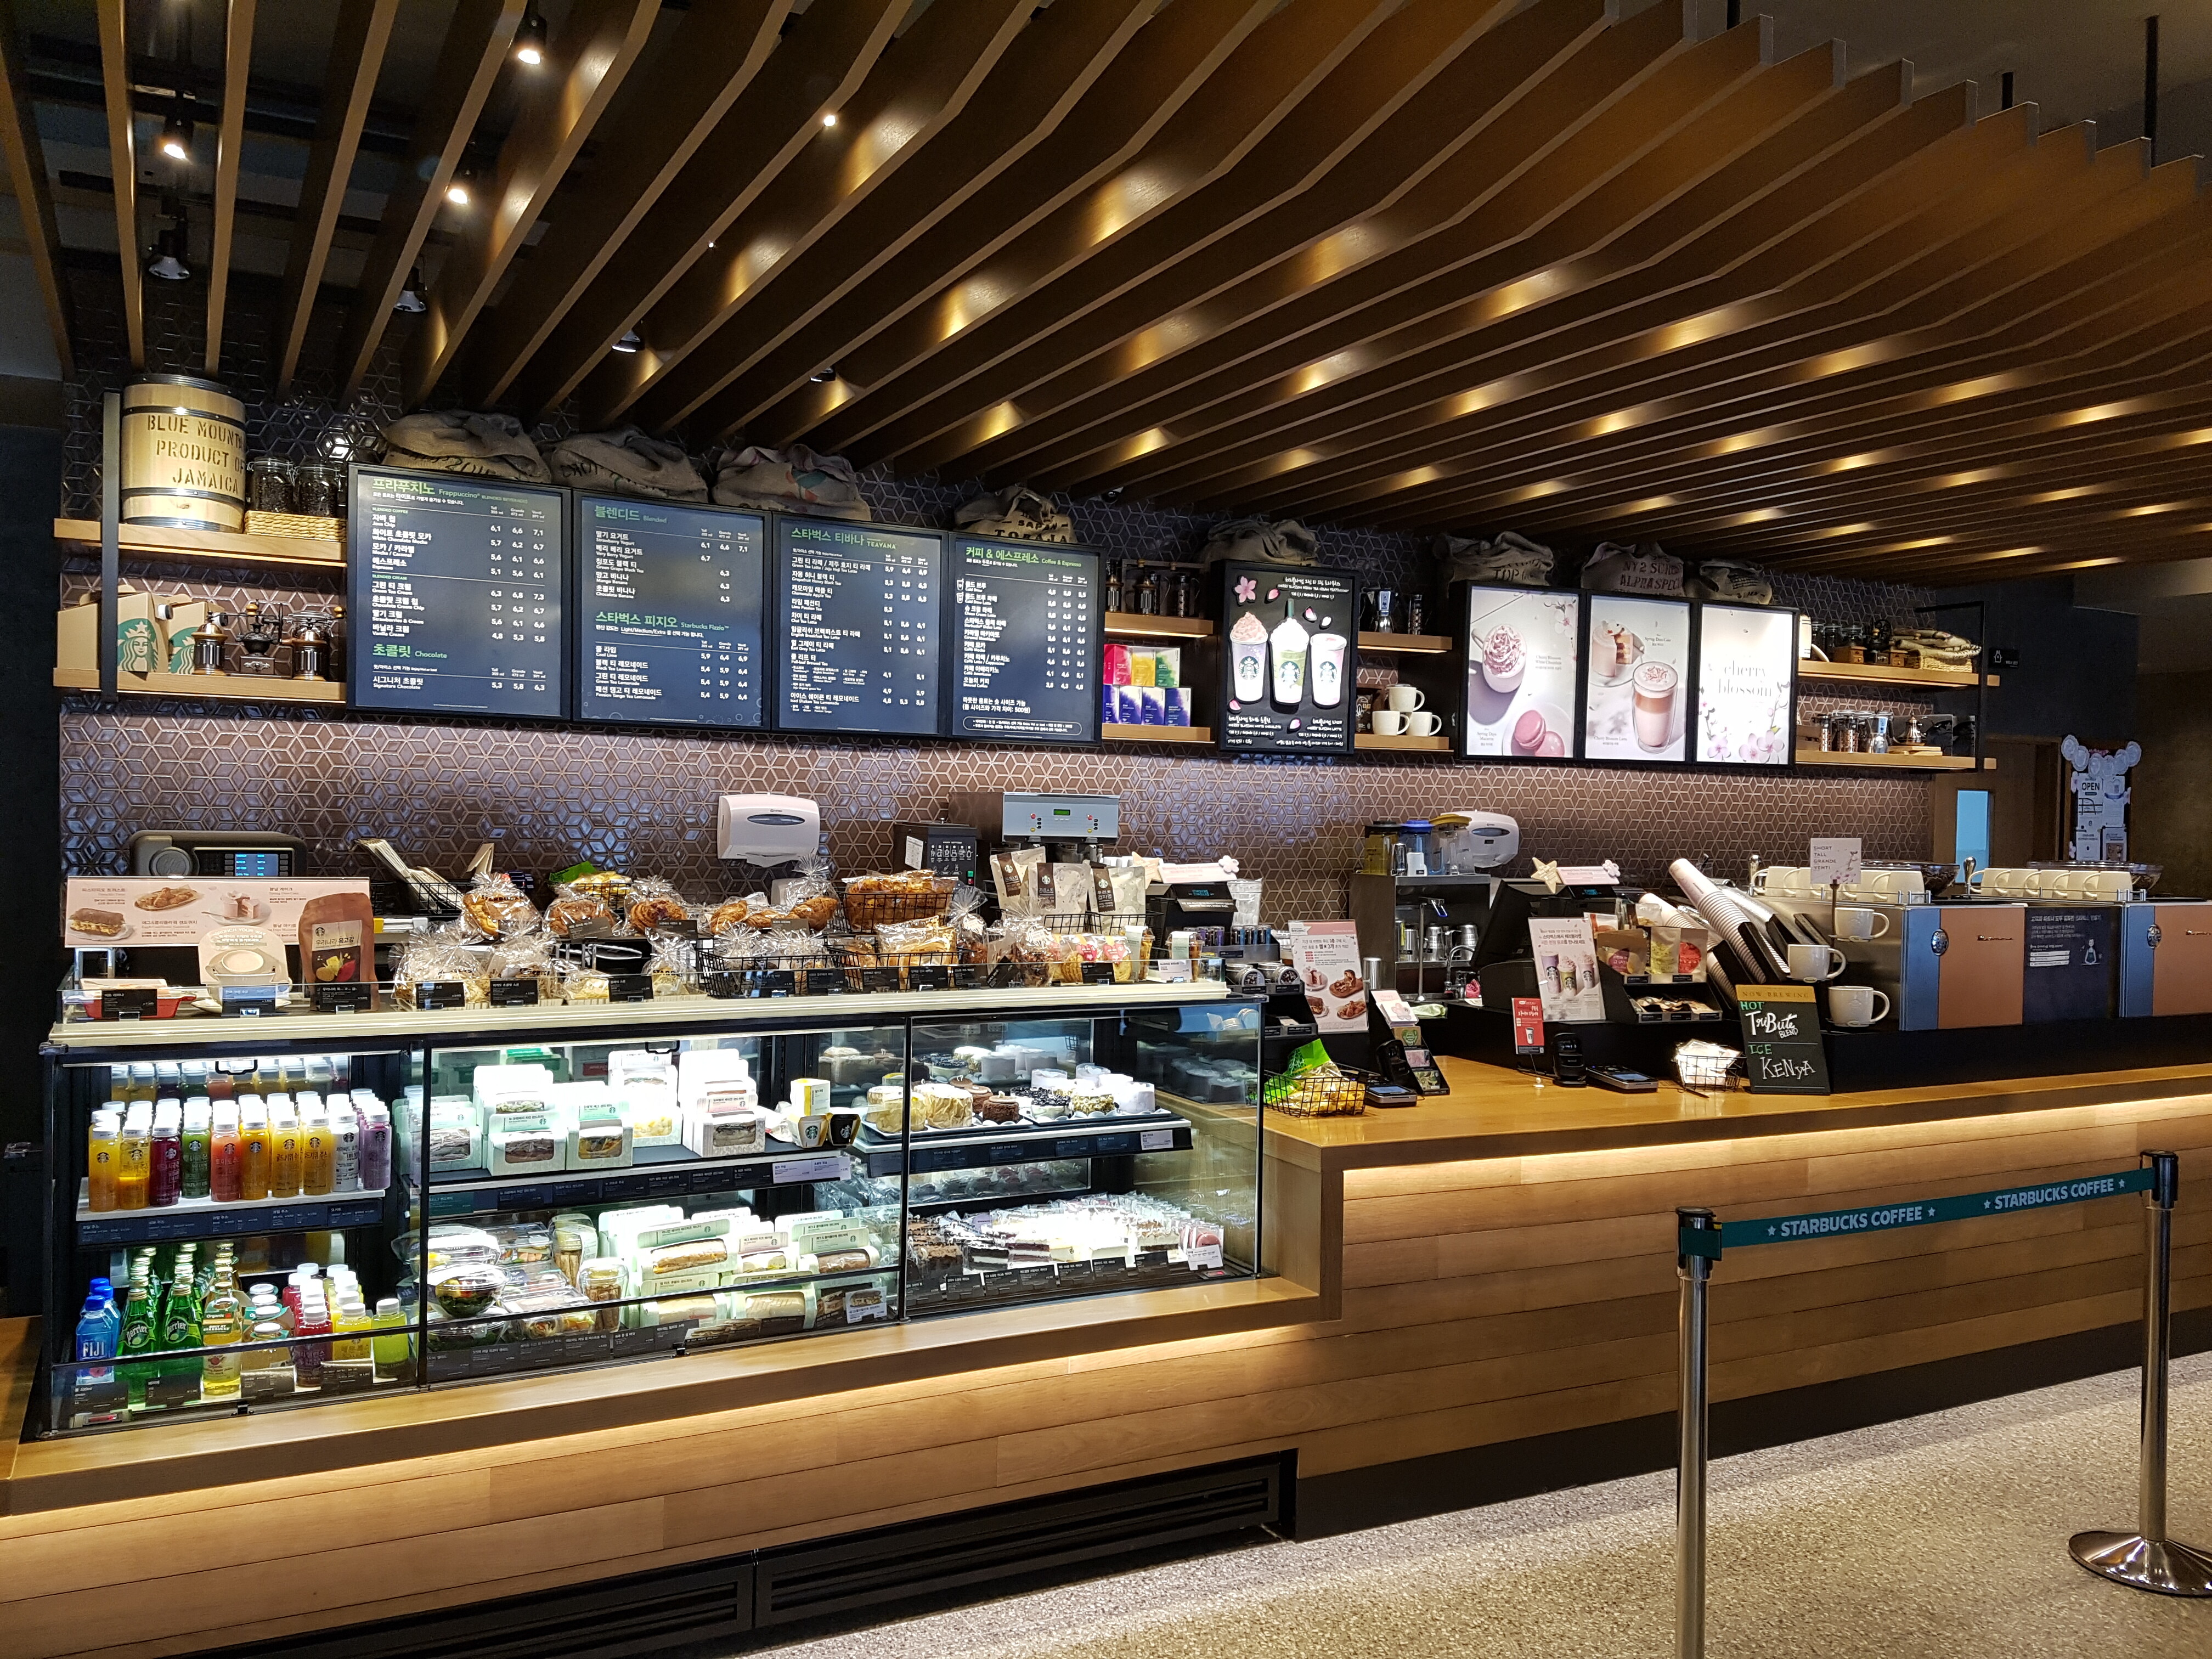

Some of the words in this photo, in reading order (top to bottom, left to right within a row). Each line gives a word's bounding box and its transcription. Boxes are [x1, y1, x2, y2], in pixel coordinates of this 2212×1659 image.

[148, 415, 189, 434] BLUE
[156, 440, 229, 467] PRODUCT
[235, 457, 245, 473] OF
[172, 468, 238, 494] JAMAICA
[372, 478, 435, 495] 프라푸치노
[372, 514, 387, 522] 자바
[595, 505, 640, 521] 블렌디드
[372, 528, 393, 538] 화이트
[395, 531, 415, 539] 초콜릿
[418, 532, 432, 540] 모카
[792, 527, 831, 541] 스타벅스
[835, 532, 864, 545] 티바나
[867, 540, 896, 549] TEAVANA
[372, 557, 407, 566] 에스프레소
[966, 547, 983, 558] 커피
[986, 549, 993, 558] &
[996, 550, 1039, 563] 에스프레소
[611, 573, 629, 581] 바나나
[372, 595, 393, 604] 초콜릿
[595, 612, 641, 625] 스타벅스
[644, 615, 678, 628] 피지오
[373, 644, 410, 658] 초콜릿
[618, 661, 648, 669] 레모네이드
[1724, 659, 1766, 677] cherry
[373, 676, 401, 685] 시그니처
[403, 678, 424, 686] 초콜릿
[1719, 679, 1772, 697] blossom
[1740, 1001, 1764, 1010] HOT
[1779, 1028, 1798, 1039] BLEND
[1748, 1045, 1772, 1054] ICE
[1995, 1186, 2068, 1210] STARBUCKS
[2071, 1178, 2114, 1198] COFFEE
[1781, 1214, 1867, 1237] STARBUCKS
[1871, 1206, 1922, 1226] COFFEE
[83, 1342, 104, 1358] FIJI
